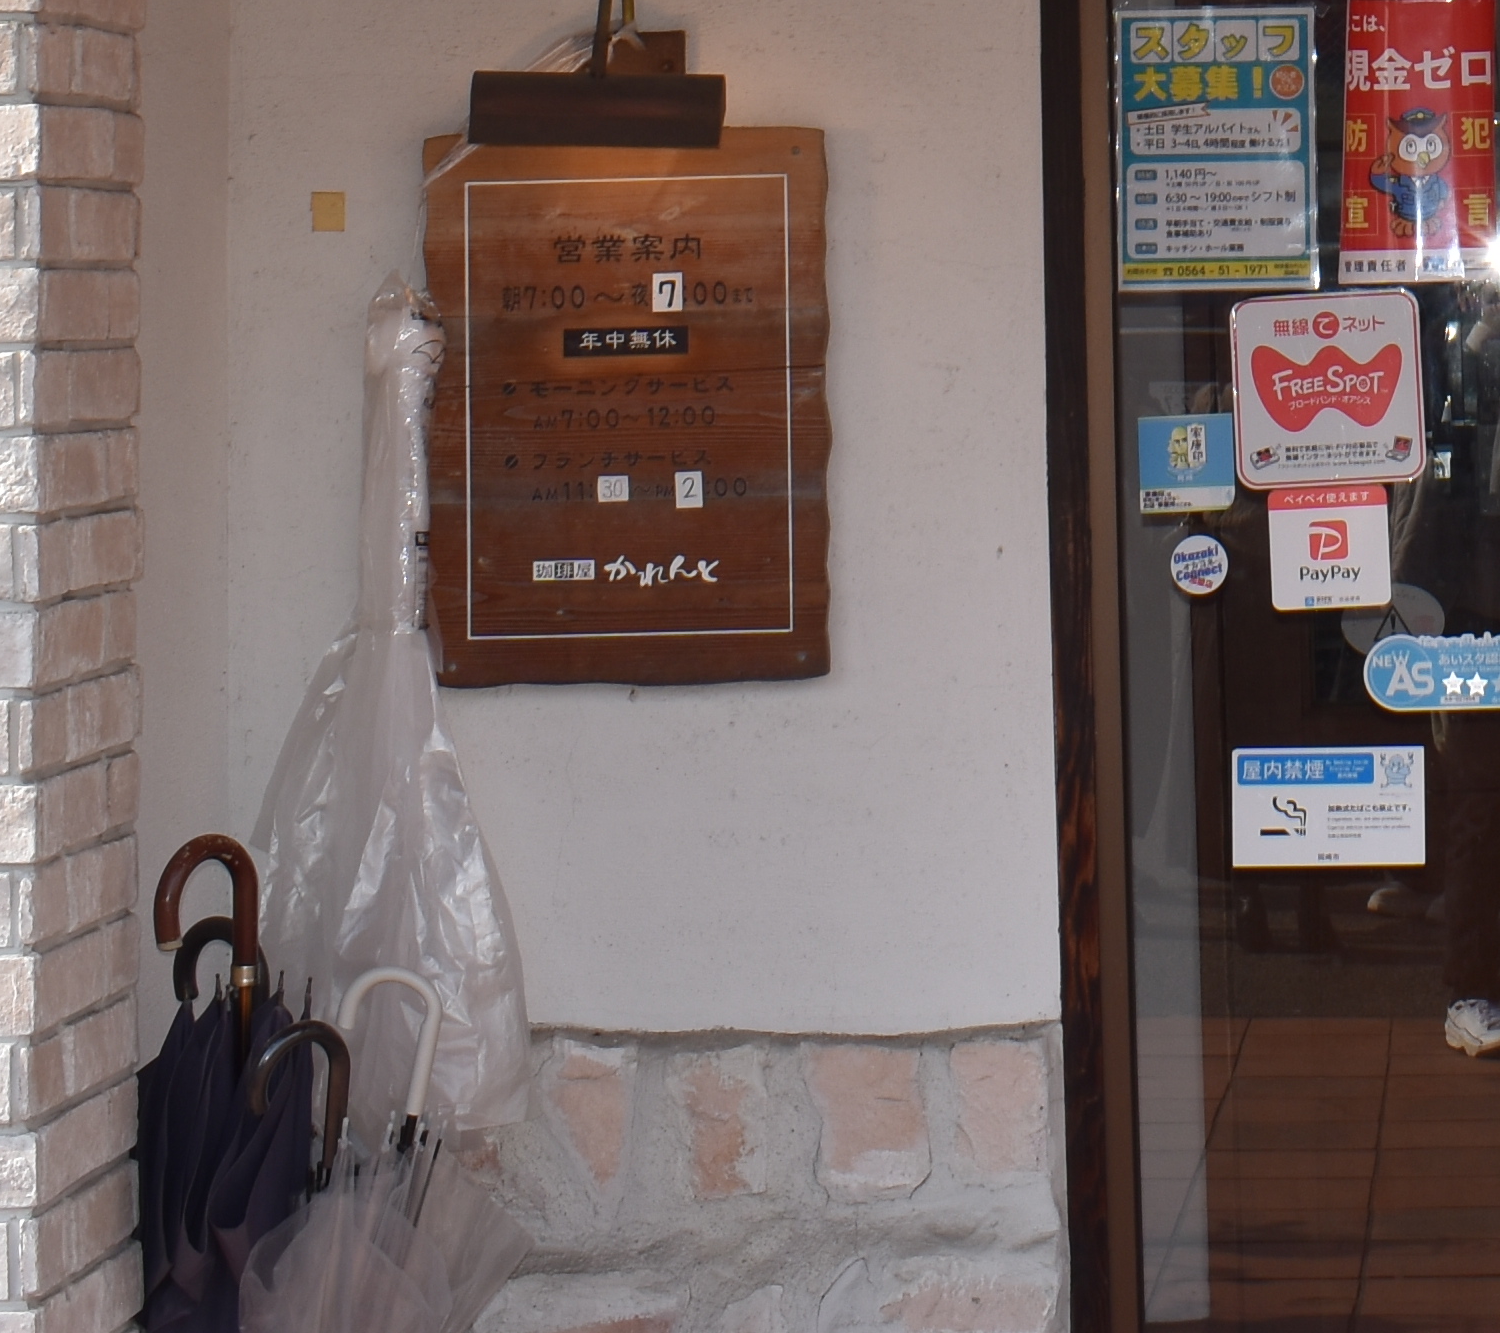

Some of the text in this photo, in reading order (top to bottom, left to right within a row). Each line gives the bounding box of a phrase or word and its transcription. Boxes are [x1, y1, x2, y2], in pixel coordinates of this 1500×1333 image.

[1134, 22, 1296, 60] スタッフ
[1134, 65, 1263, 101] 大募集！
[1461, 117, 1490, 150] 犯
[1463, 194, 1491, 226] 言
[553, 233, 701, 263] 営業案内
[579, 329, 678, 350] 年中無休
[1284, 491, 1369, 504] ペイペイ使えます
[535, 554, 720, 587] 珈琲屋 かれんと
[1300, 564, 1361, 583] PayPay
[1386, 661, 1434, 696] AS
[1243, 759, 1324, 780] 屋内禁煙
